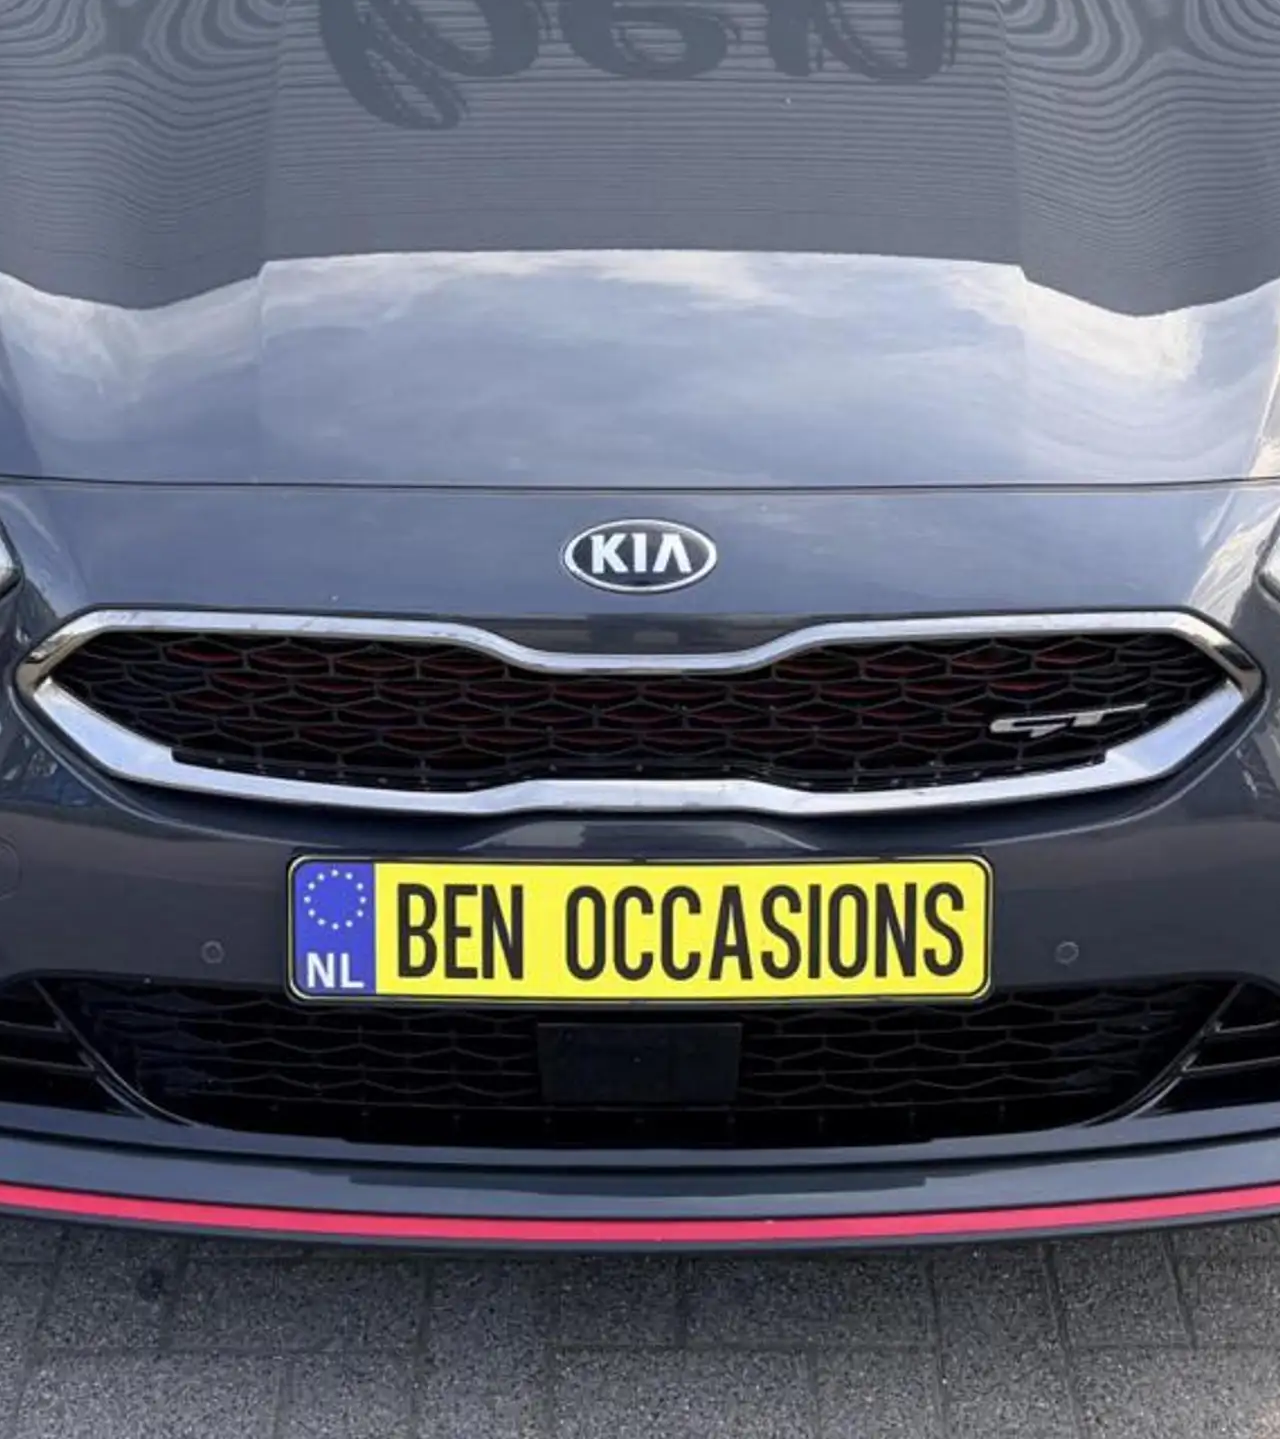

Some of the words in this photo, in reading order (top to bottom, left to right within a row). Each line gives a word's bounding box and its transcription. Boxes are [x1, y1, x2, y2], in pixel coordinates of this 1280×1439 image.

[590, 532, 693, 574] KIA
[989, 702, 1148, 738] GT
[396, 882, 525, 980] BEN
[565, 882, 966, 981] OCCASIONS
[305, 951, 365, 990] NL
